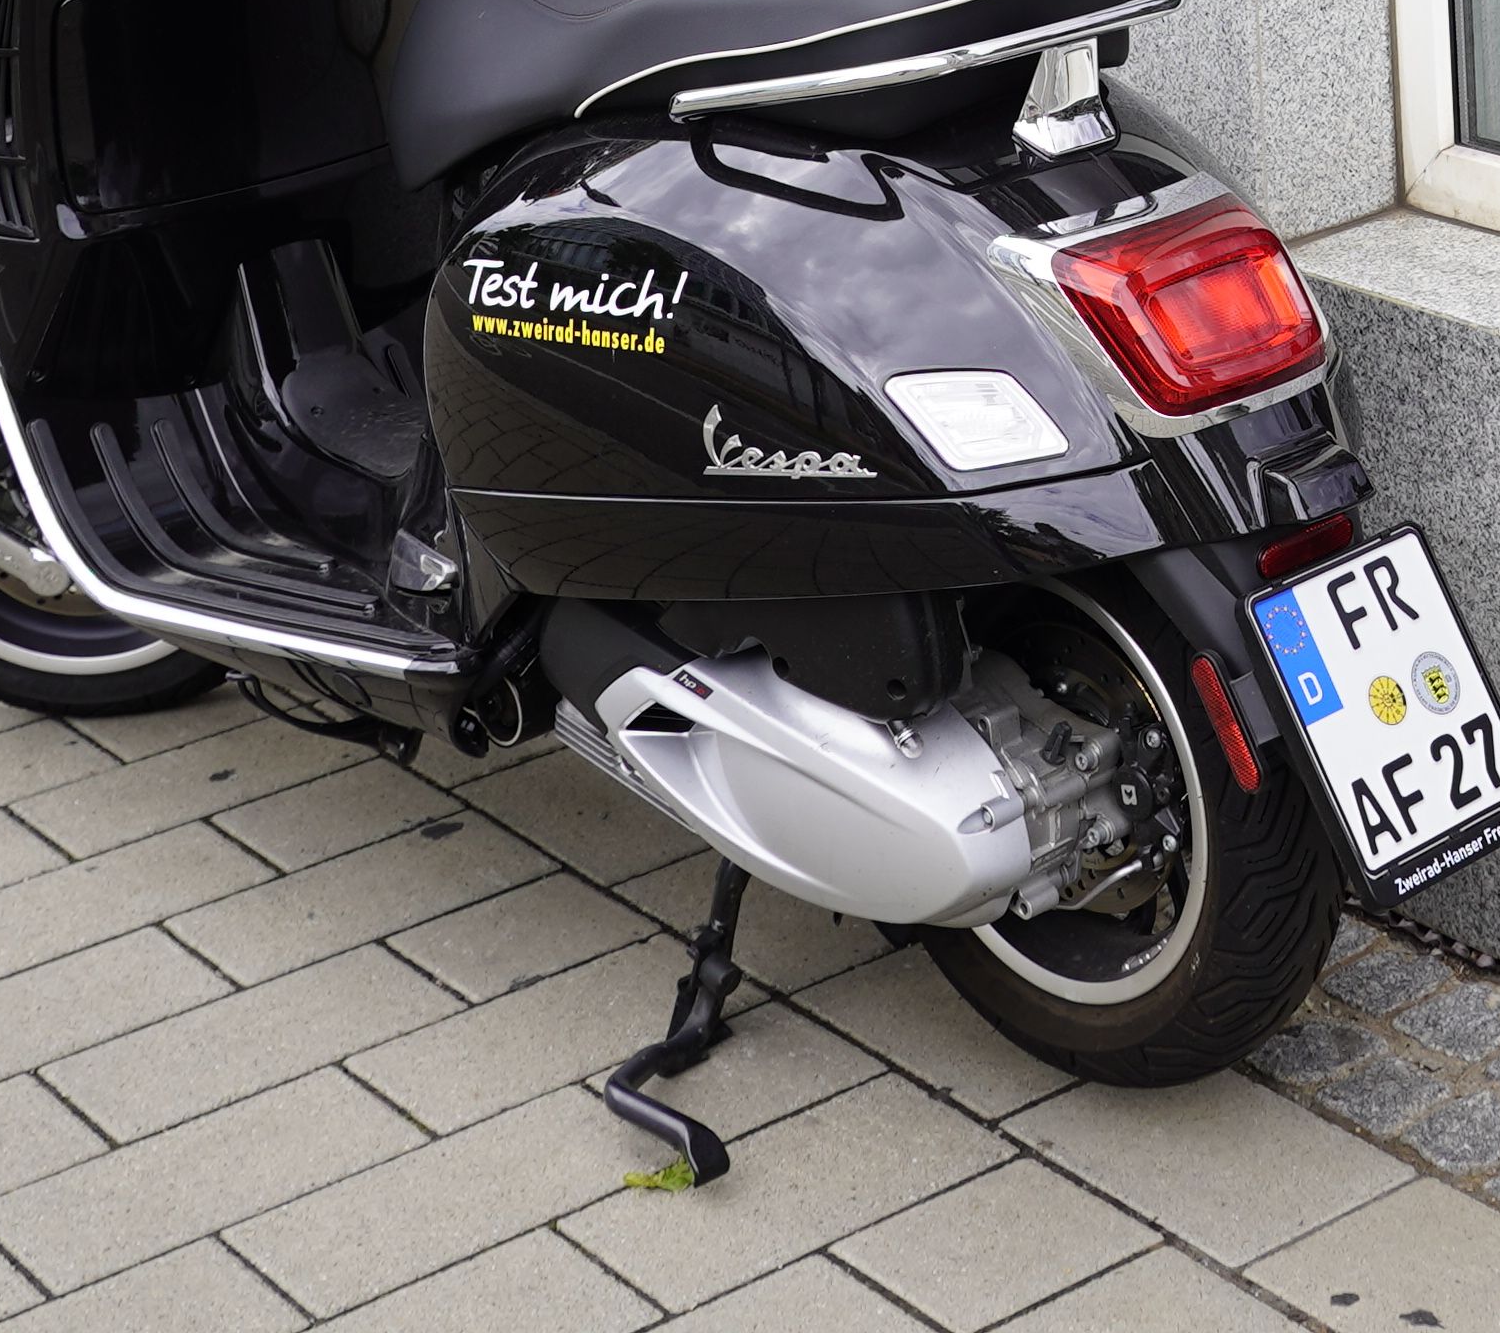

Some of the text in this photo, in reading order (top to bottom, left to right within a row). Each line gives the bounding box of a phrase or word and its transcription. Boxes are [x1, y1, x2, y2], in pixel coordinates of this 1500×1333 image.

[463, 259, 688, 320] Test mich!
[472, 313, 666, 354] www.zweirad-hanser.de
[703, 403, 877, 479] Vespa
[1327, 556, 1420, 650] FR
[1298, 671, 1323, 705] D
[1351, 753, 1424, 855] AF
[1394, 836, 1483, 895] Zweirad-Hanser
